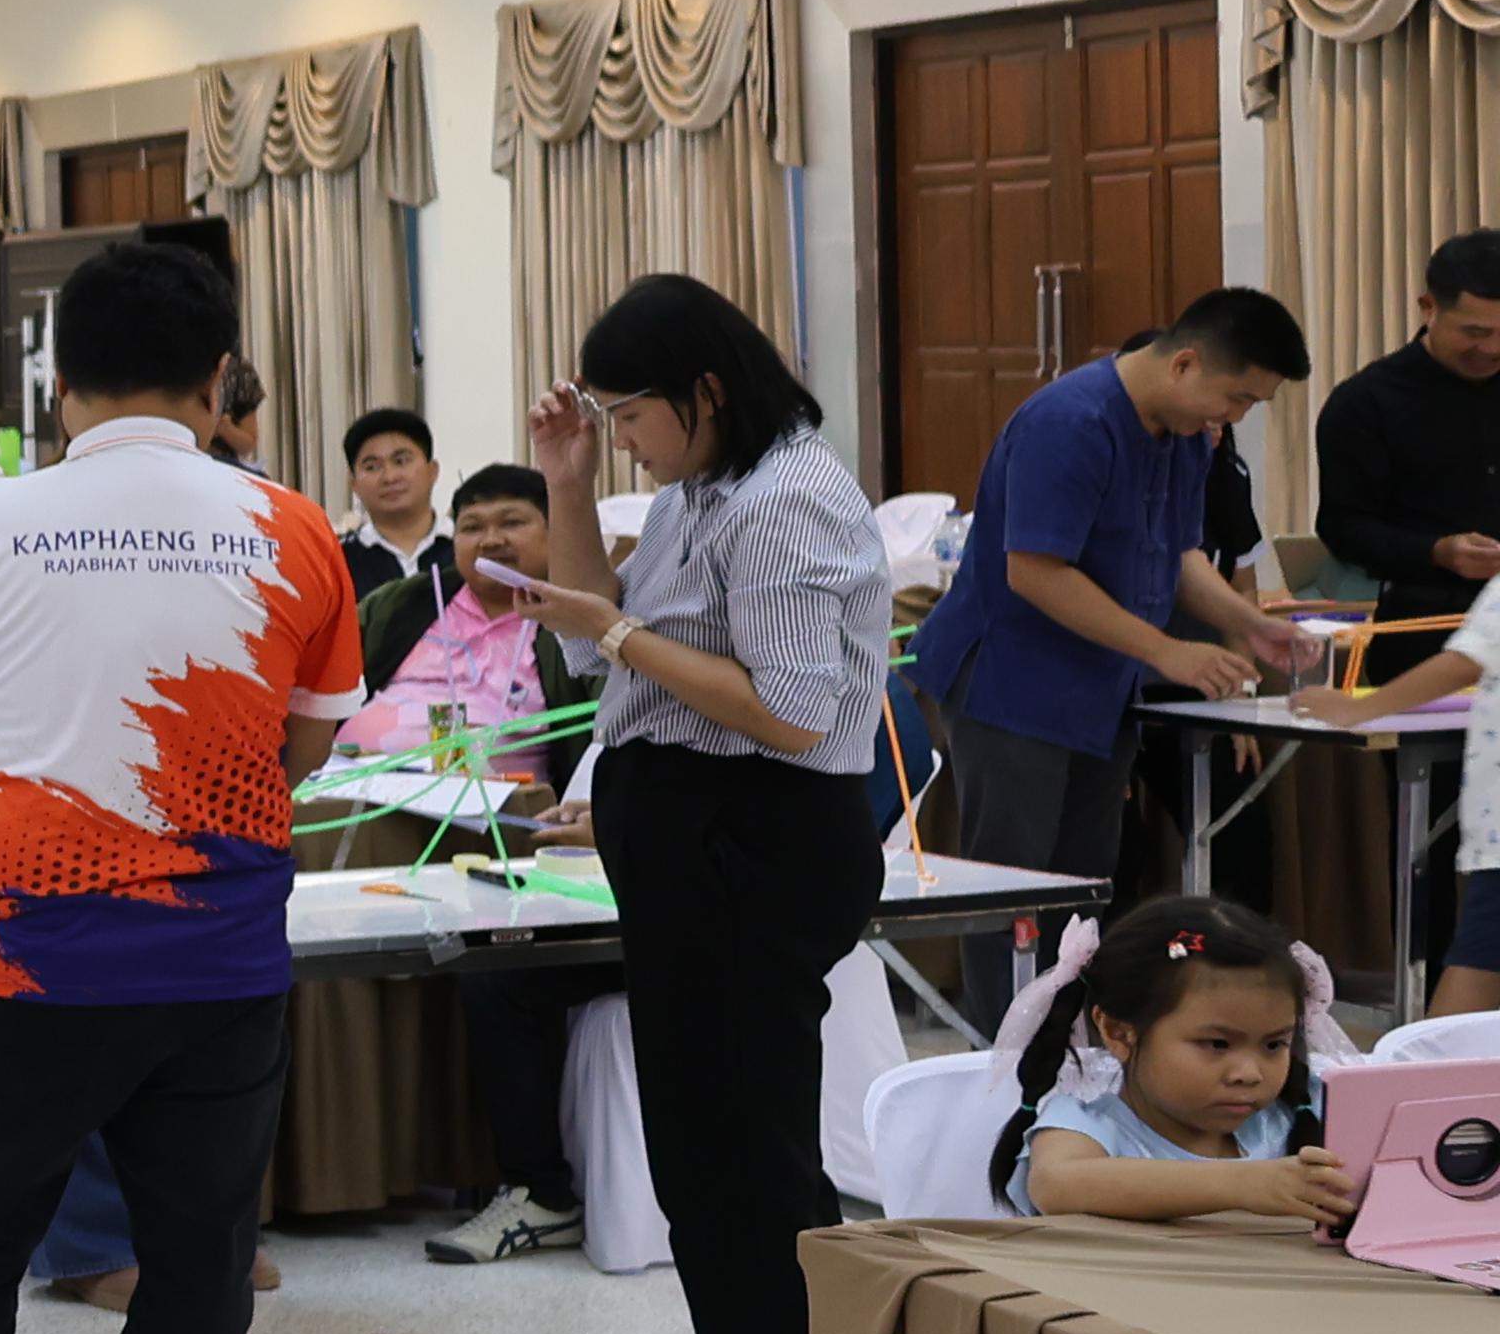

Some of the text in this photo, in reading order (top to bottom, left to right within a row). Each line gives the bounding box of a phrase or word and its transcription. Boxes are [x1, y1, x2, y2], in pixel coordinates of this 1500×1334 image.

[13, 530, 277, 560] KAMPHAENG PHET
[44, 558, 251, 576] RAJABHAT UNIVERSITY
